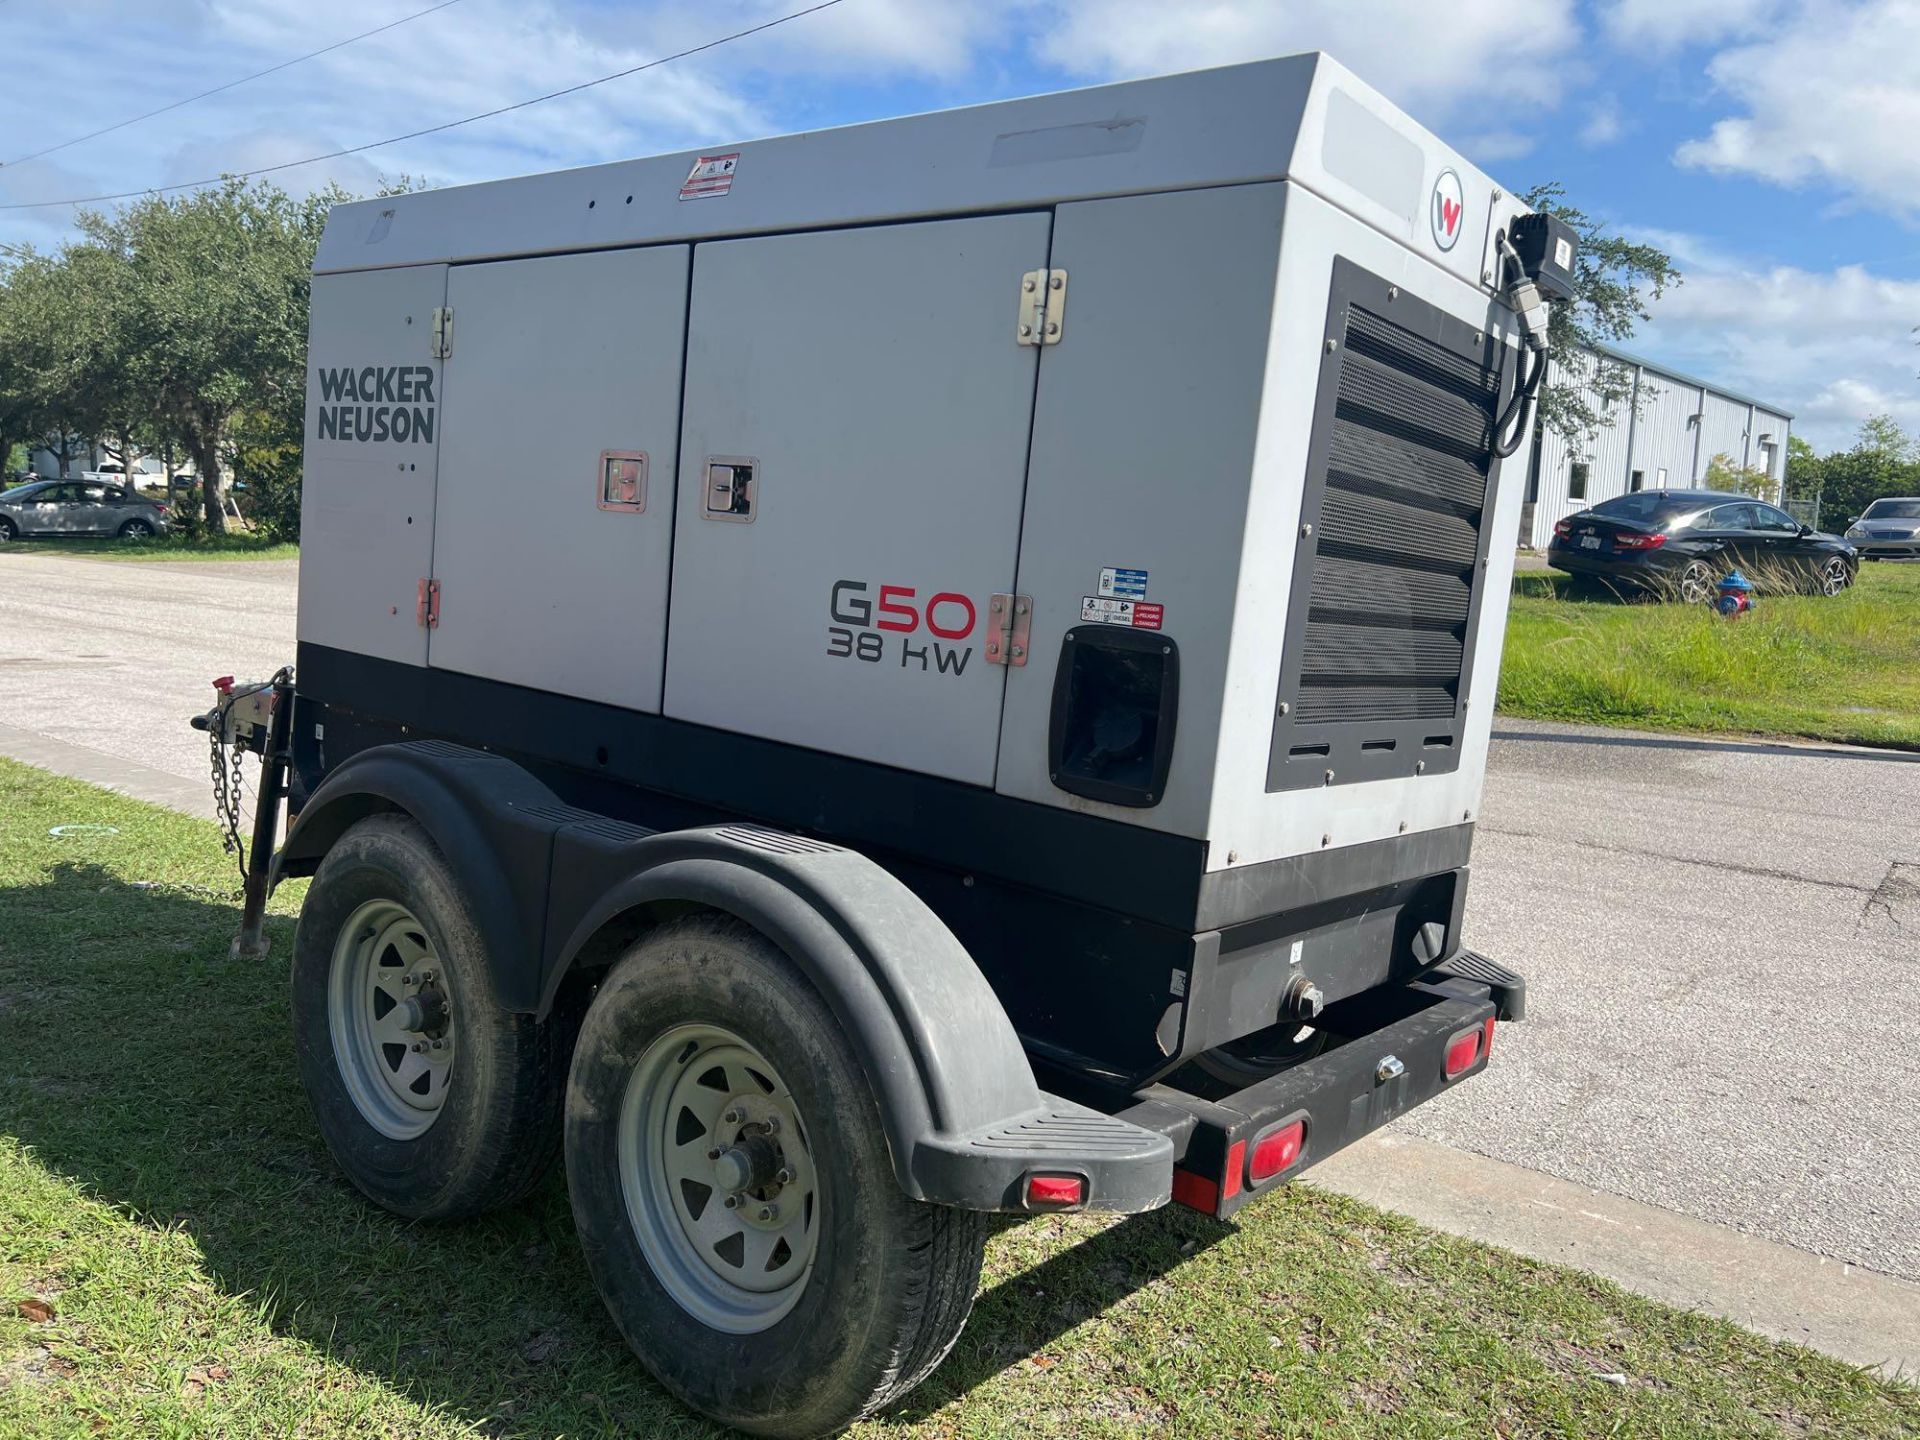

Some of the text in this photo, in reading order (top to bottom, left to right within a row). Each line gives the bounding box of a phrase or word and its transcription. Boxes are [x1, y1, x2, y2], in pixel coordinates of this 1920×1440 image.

[318, 366, 435, 402] WACKER
[318, 406, 434, 443] NEUSON
[831, 580, 976, 640] G50
[827, 627, 973, 676] 38 kW
